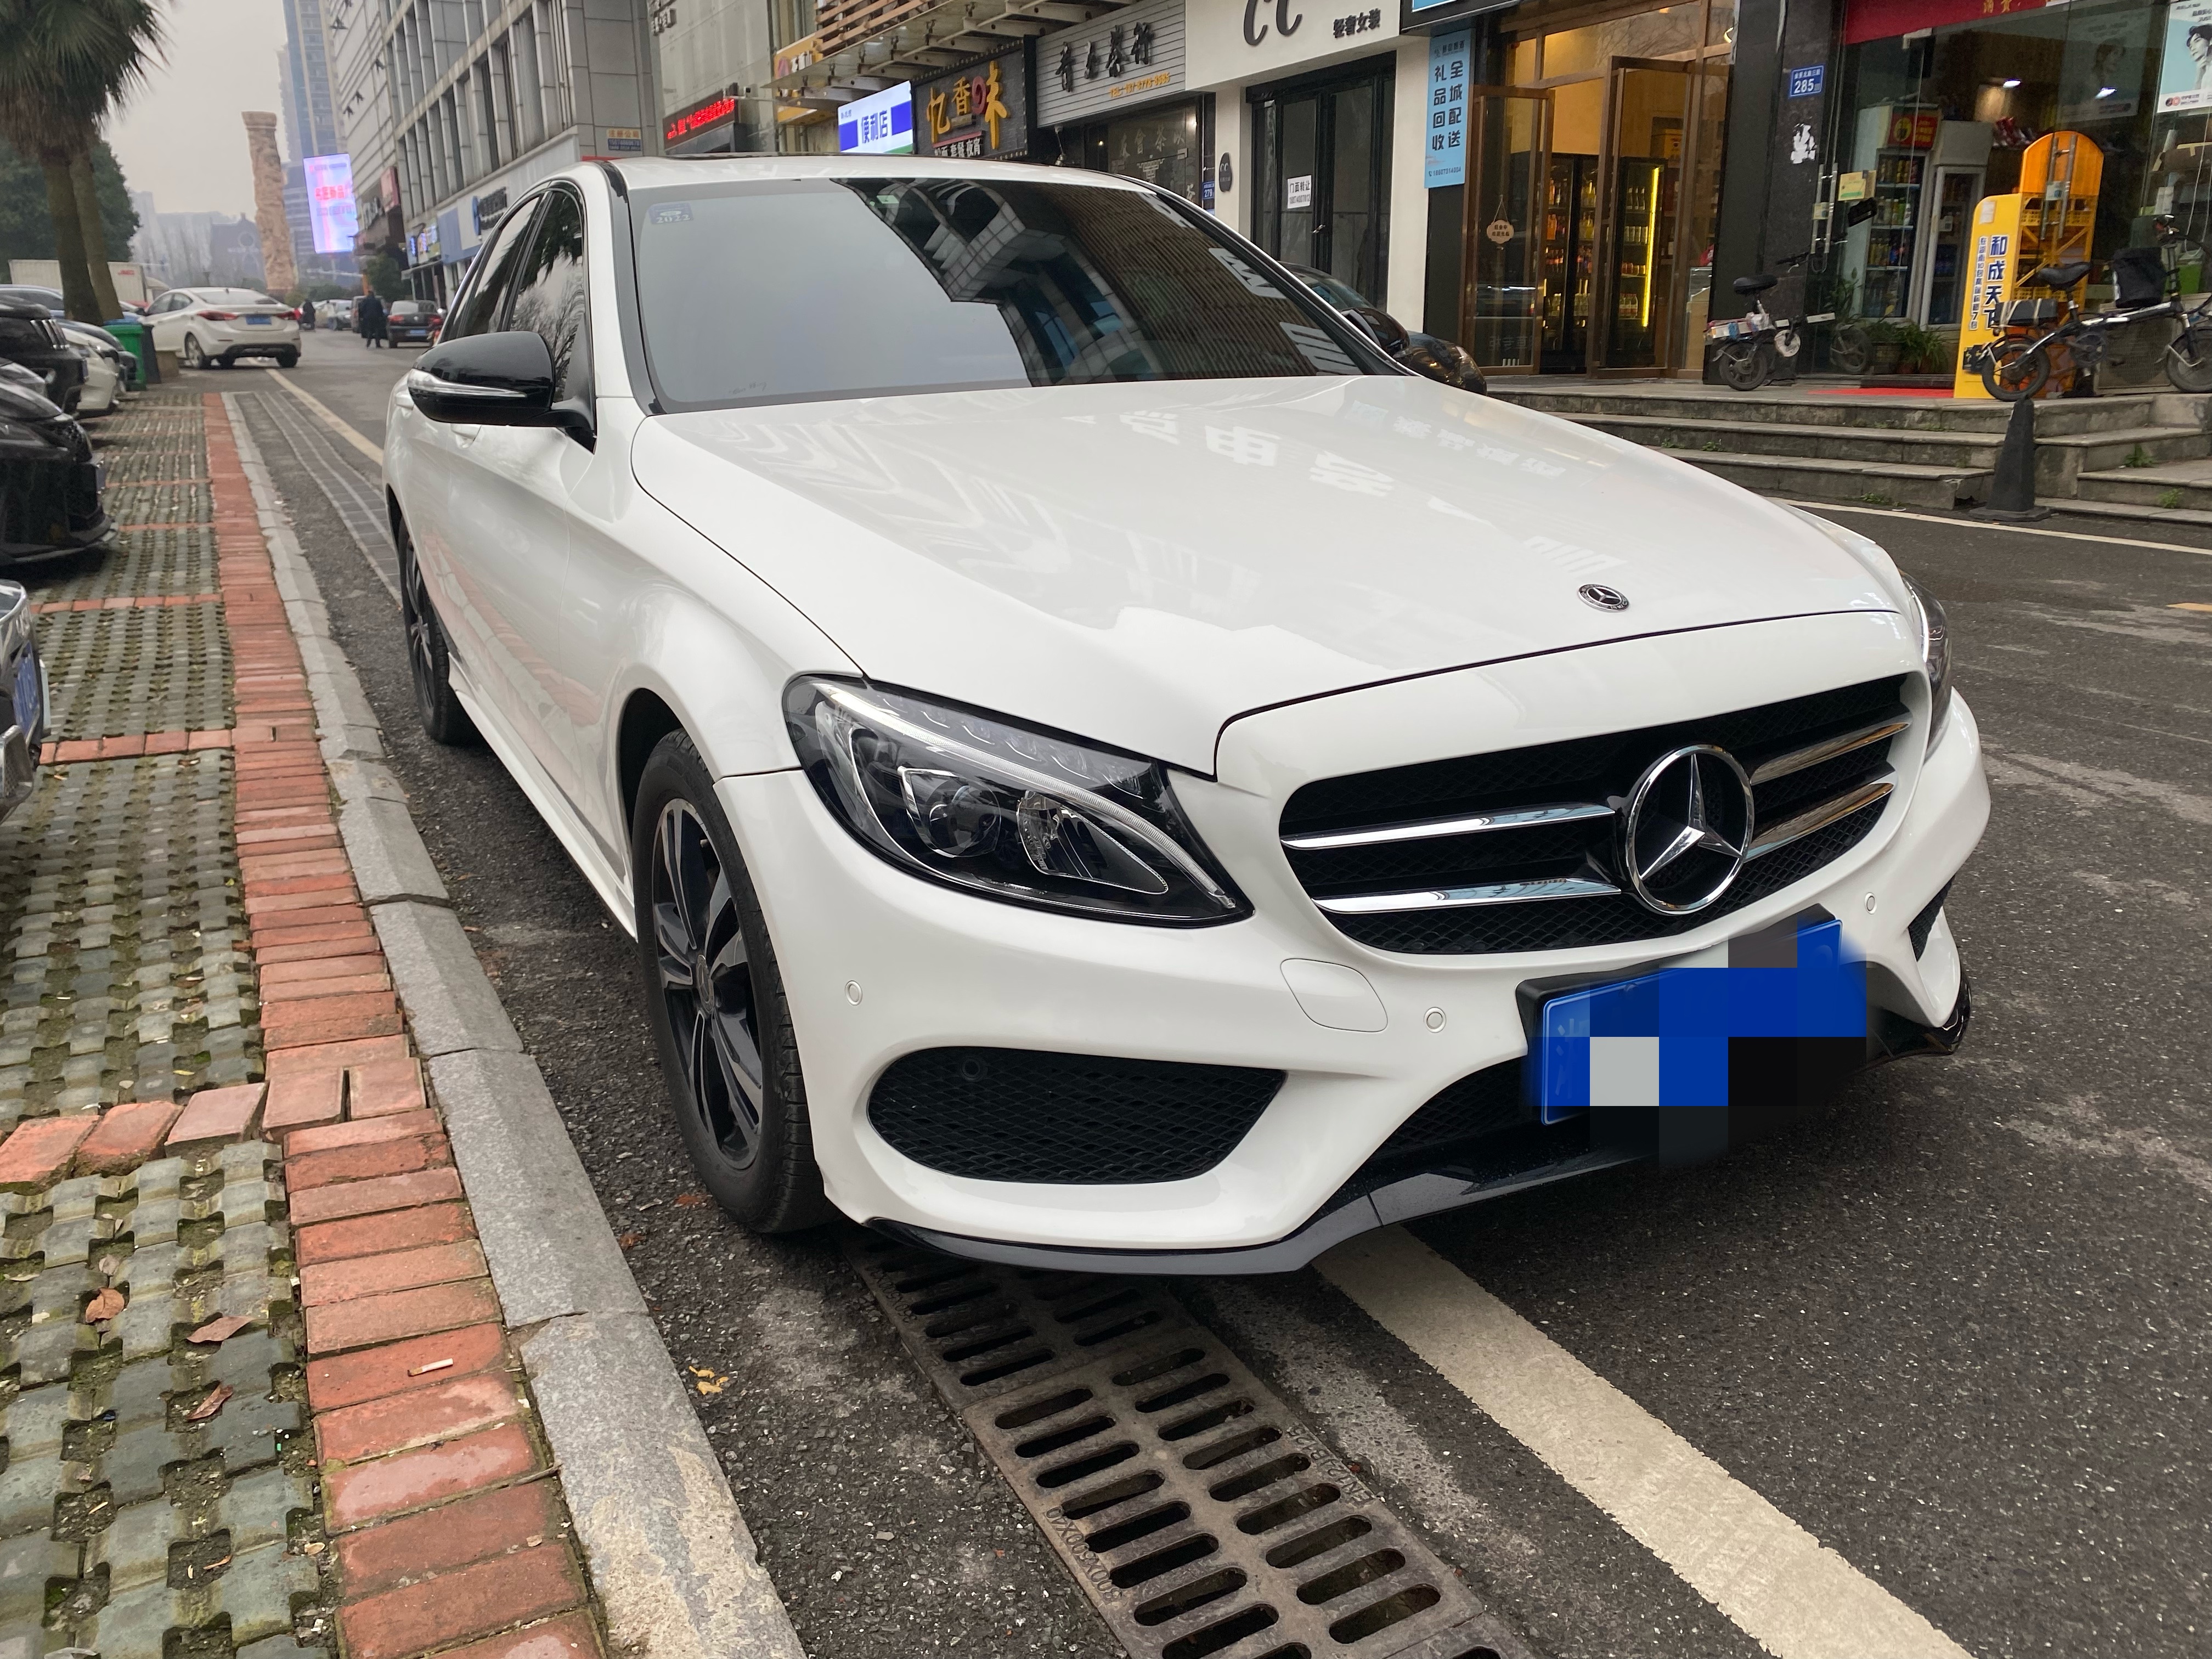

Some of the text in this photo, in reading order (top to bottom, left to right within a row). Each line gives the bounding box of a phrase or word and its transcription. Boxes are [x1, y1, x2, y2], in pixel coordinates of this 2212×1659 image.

[1333, 8, 1381, 39] 轻奢女装
[1794, 78, 1814, 94] 285
[1432, 64, 1447, 151] 礼品回收
[1448, 60, 1464, 148] 全城配送
[861, 110, 888, 144] 便利店
[1220, 163, 1228, 172] CC
[1290, 180, 1310, 193] 门面转让
[657, 214, 691, 223] 2022
[1983, 235, 2008, 329] 和成天下
